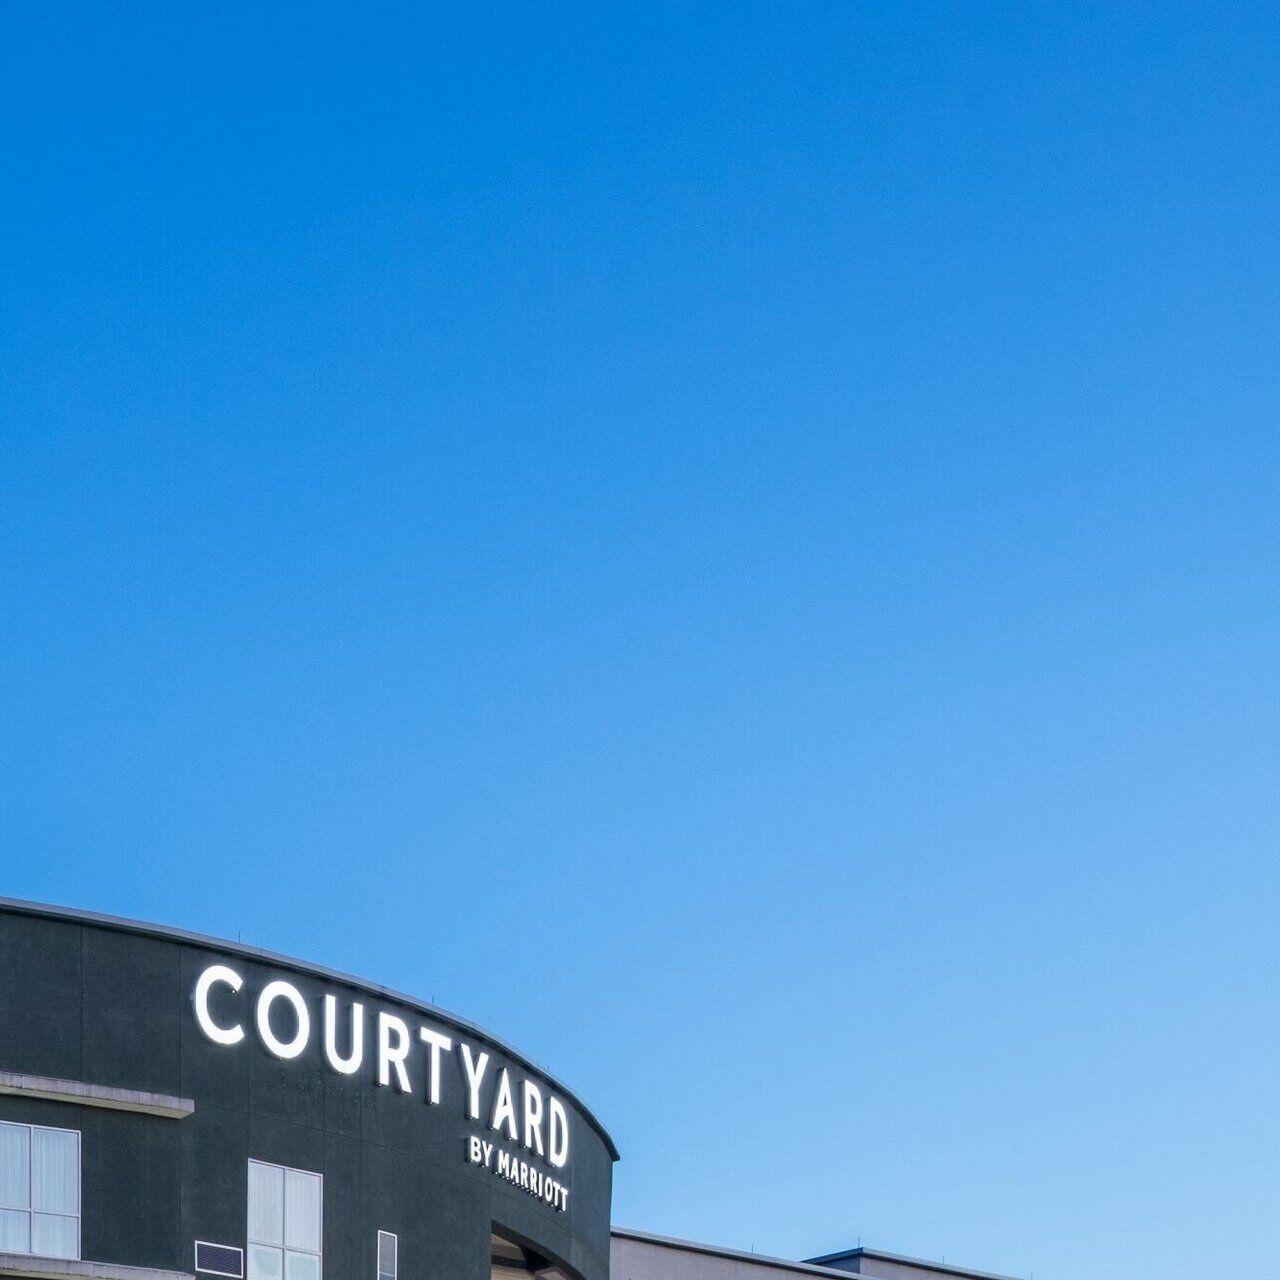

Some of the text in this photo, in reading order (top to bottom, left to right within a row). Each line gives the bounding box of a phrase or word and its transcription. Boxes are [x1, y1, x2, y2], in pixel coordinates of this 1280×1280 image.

[194, 965, 569, 1168] COURTYARD
[470, 1135, 568, 1211] BY MARRIOTT
